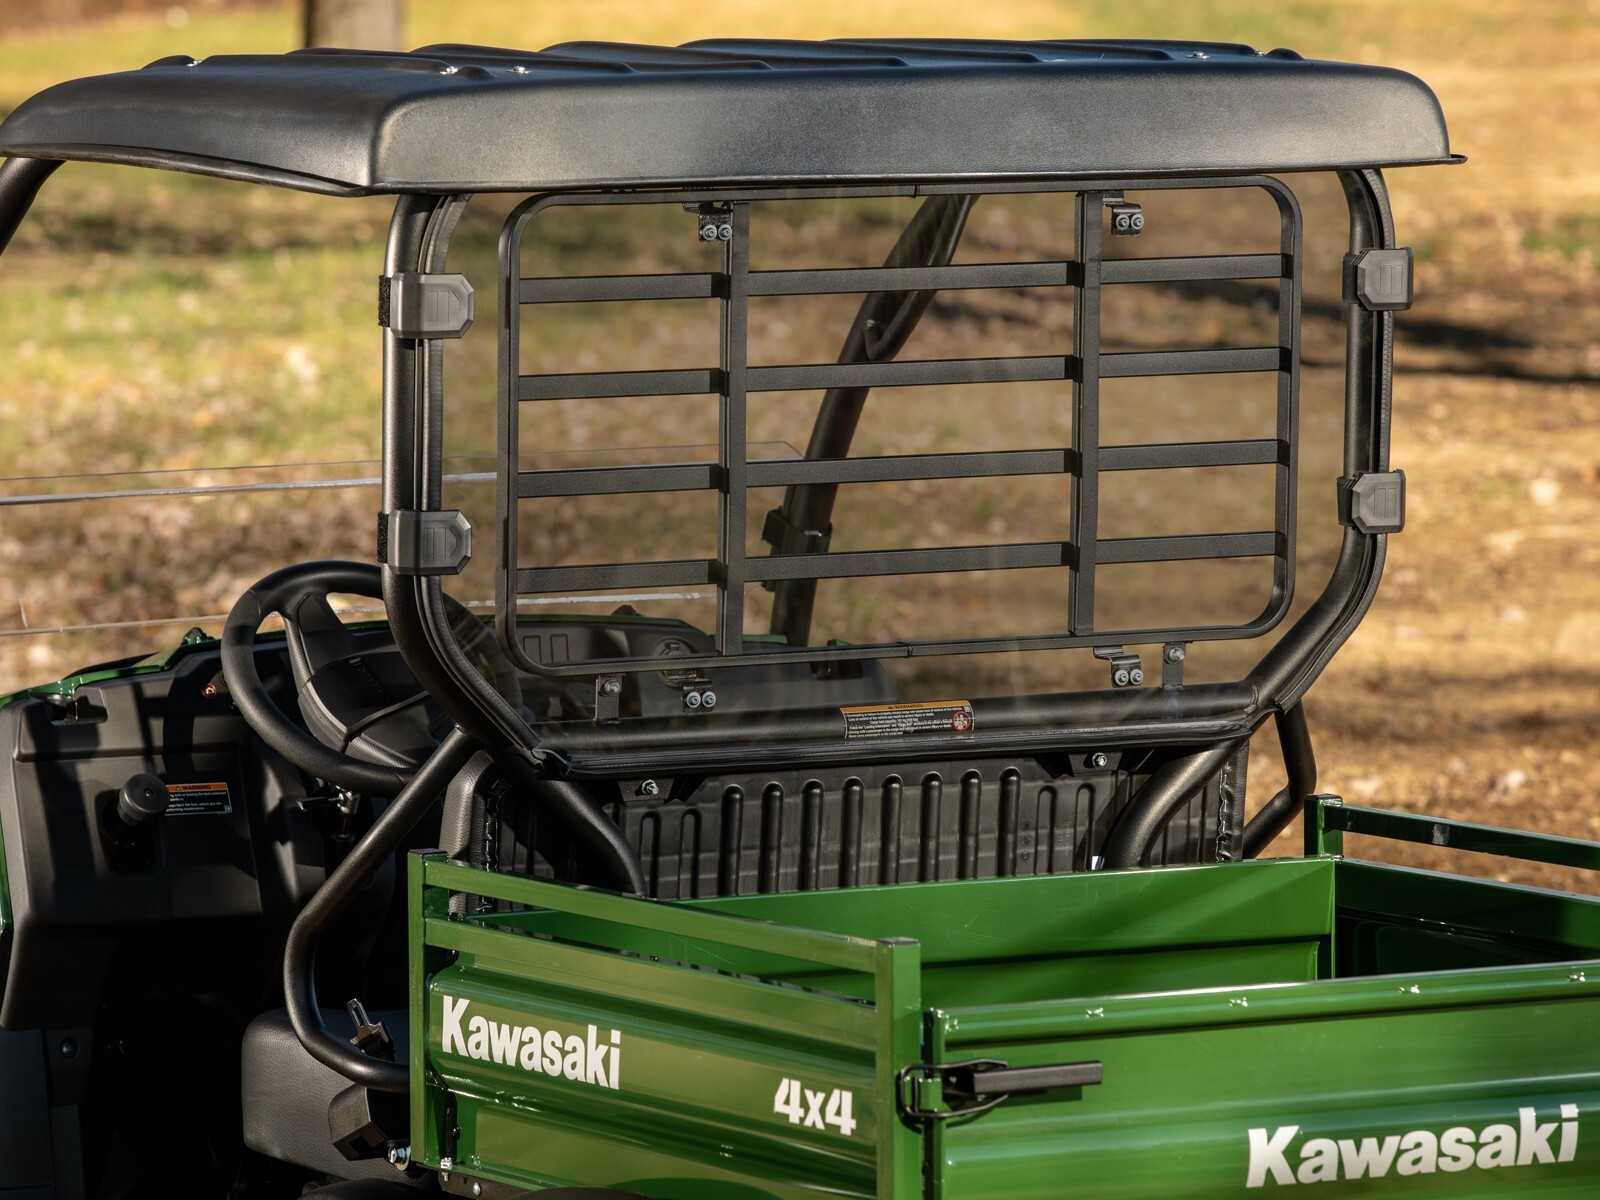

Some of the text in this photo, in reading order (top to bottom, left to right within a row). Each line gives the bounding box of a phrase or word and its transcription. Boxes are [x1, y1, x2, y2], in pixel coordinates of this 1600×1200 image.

[442, 995, 621, 1090] Kawasaki
[774, 1077, 857, 1136] 4x4
[1246, 1103, 1579, 1188] Kawasaki
